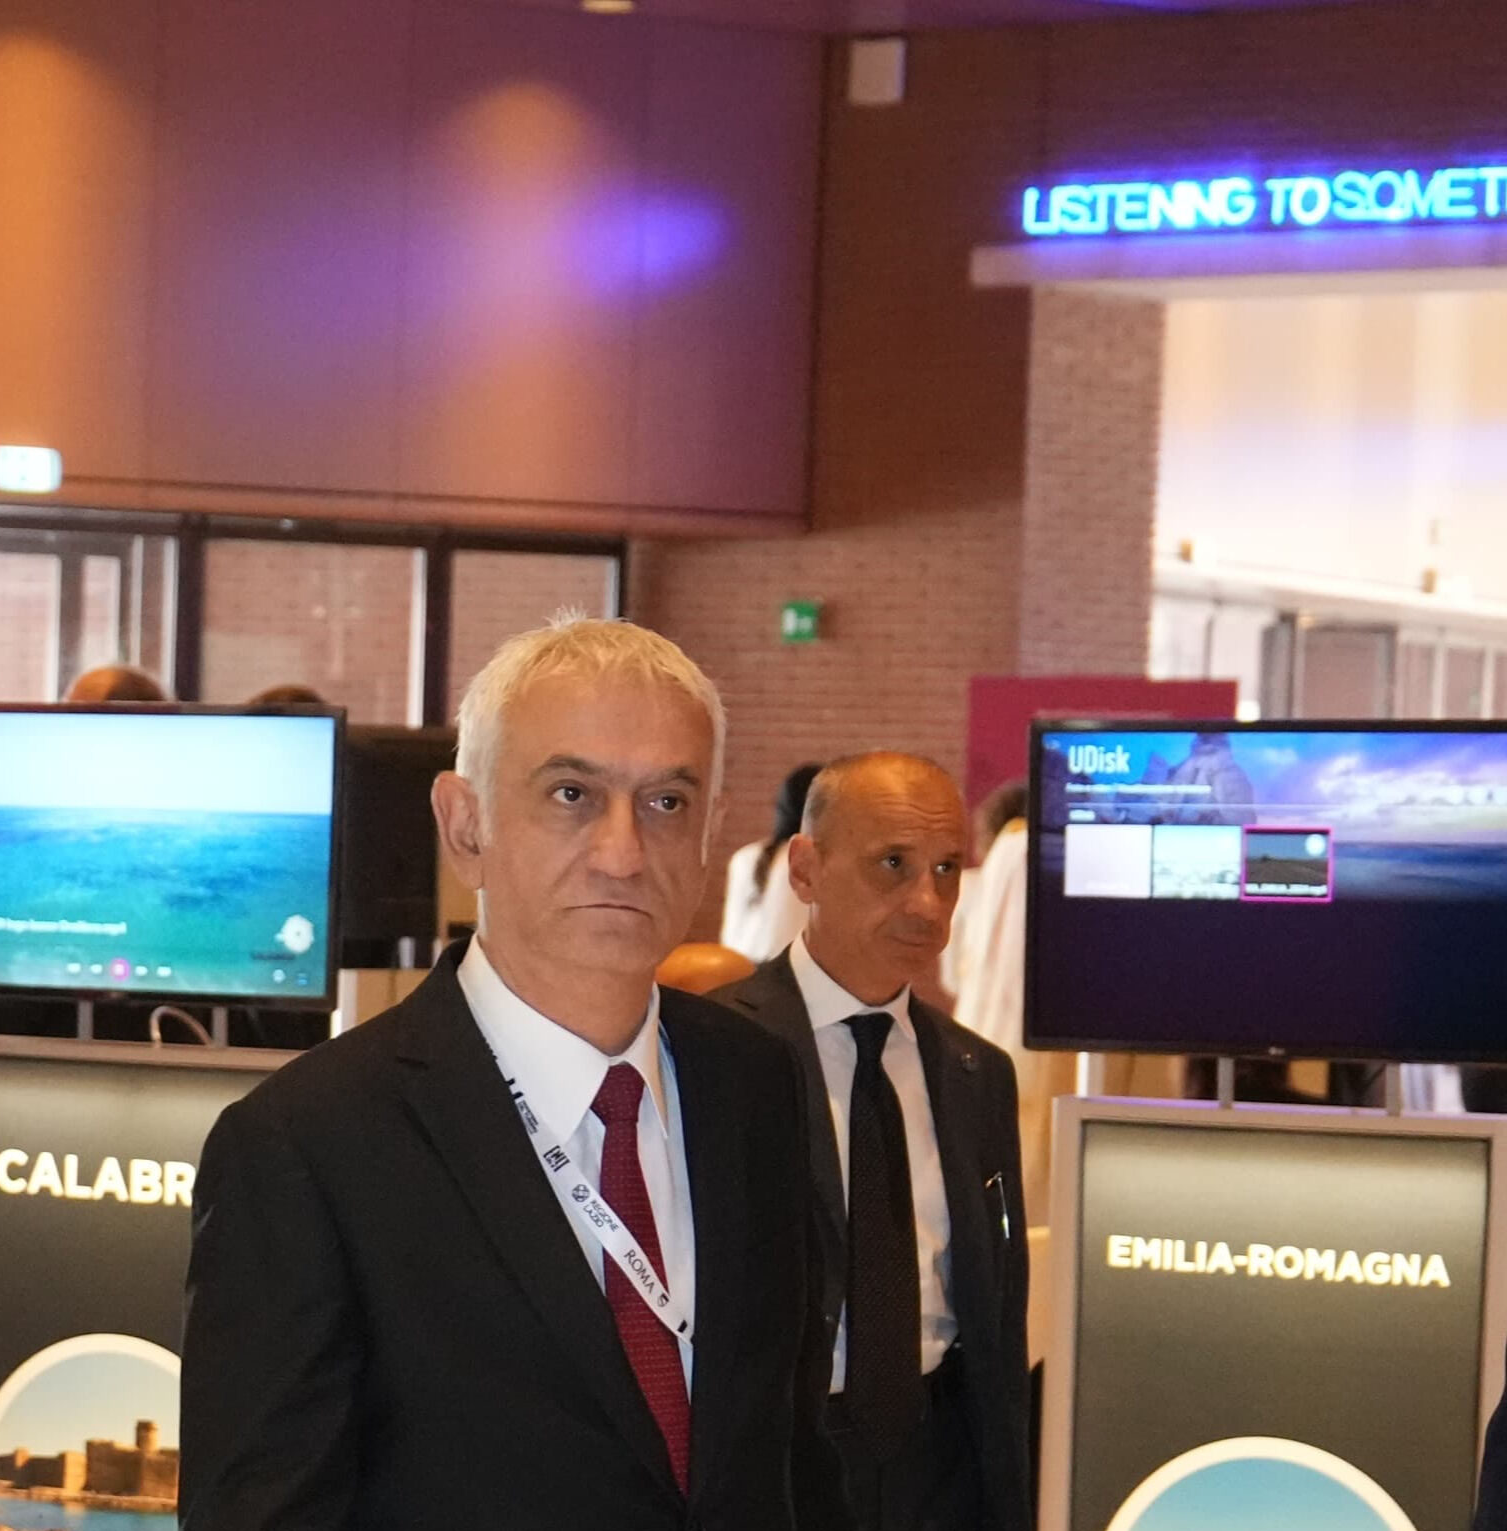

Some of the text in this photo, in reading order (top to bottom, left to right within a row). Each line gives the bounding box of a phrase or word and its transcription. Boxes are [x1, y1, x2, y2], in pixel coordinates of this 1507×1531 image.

[1266, 176, 1331, 225] TO
[1331, 166, 1507, 222] SOMET
[1068, 745, 1130, 774] UDisk
[583, 1203, 603, 1228] LAZIO
[590, 1199, 619, 1233] REGIONE
[623, 1249, 655, 1294] ROMA
[1107, 1234, 1451, 1288] EMILIA-ROMAGNA
